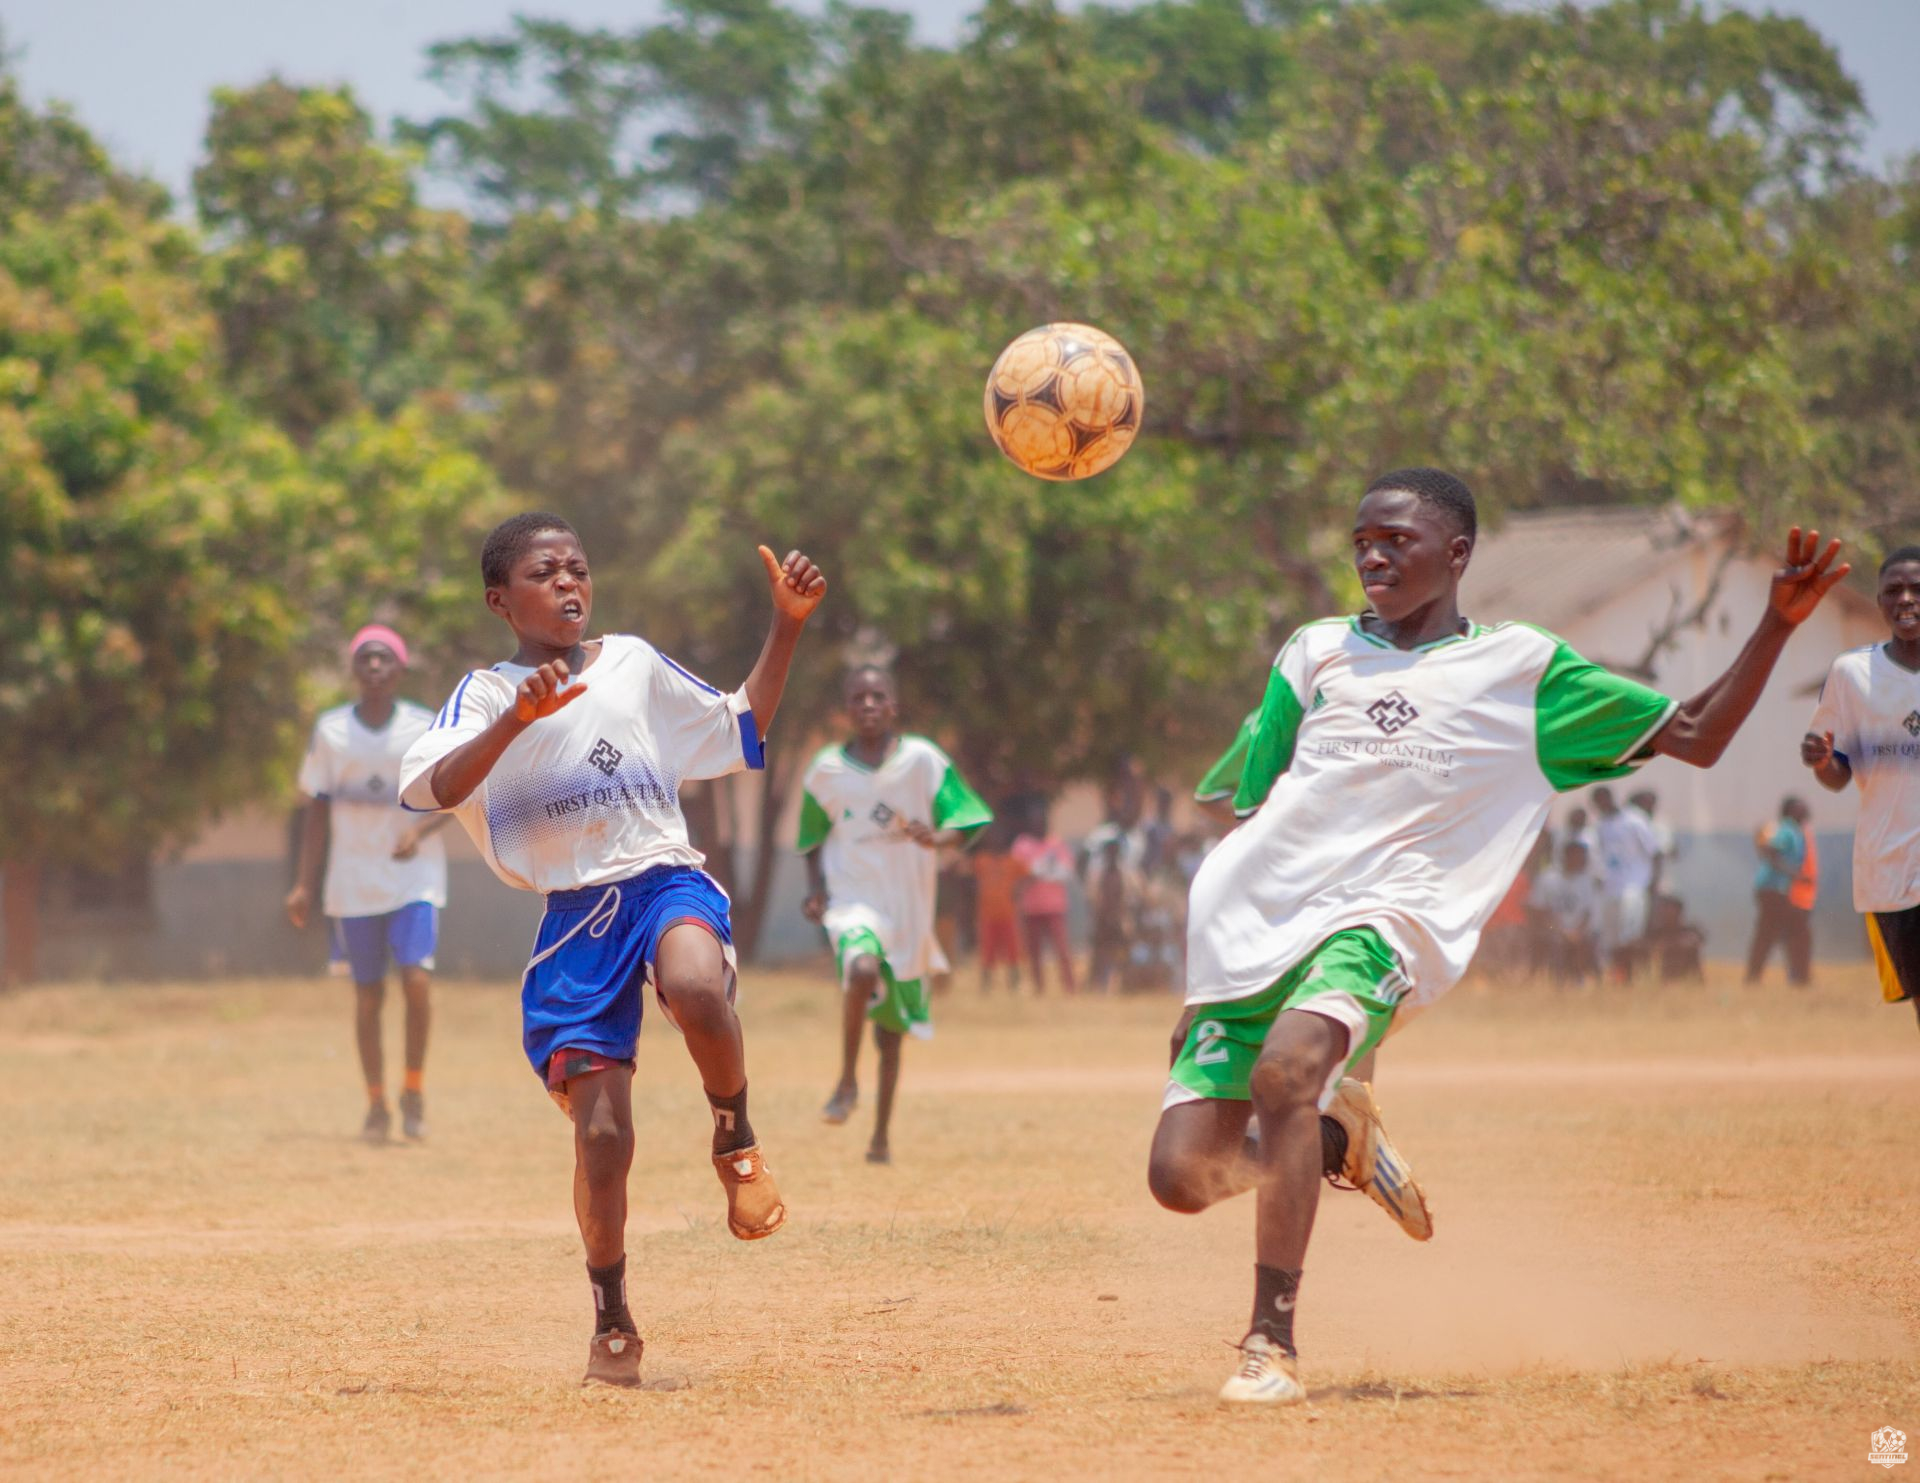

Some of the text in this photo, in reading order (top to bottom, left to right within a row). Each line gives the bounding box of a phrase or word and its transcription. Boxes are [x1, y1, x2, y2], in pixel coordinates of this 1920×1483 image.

[1317, 740, 1454, 767] FIRST QUANTUM
[1380, 758, 1431, 773] MINERALS
[545, 792, 590, 819] FIRST
[1194, 1019, 1230, 1066] 2
